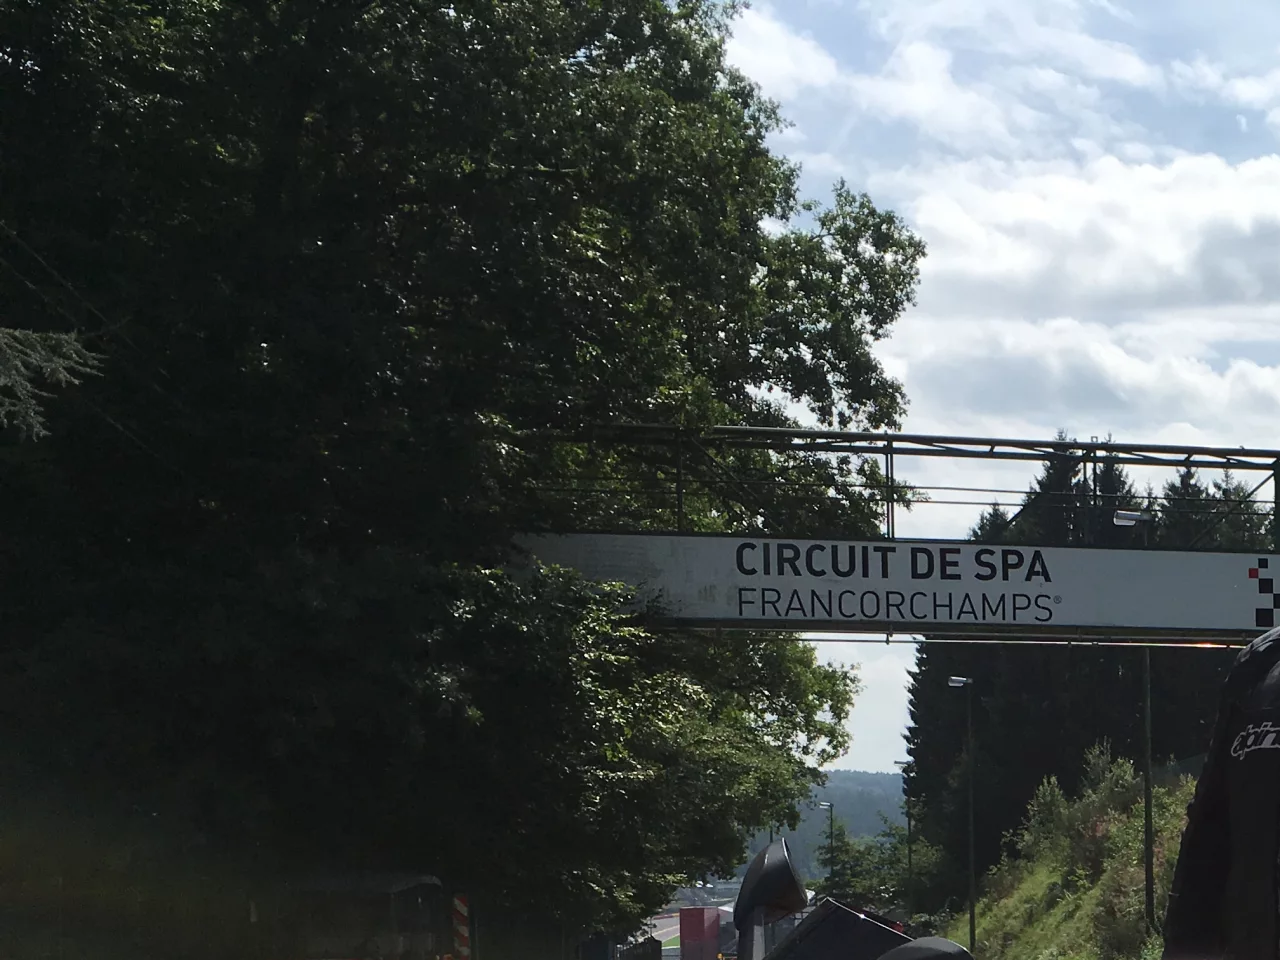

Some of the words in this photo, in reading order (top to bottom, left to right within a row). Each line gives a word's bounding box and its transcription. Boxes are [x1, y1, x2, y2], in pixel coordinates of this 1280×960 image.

[735, 542, 897, 579] CIRCUIT
[910, 548, 962, 580] DE
[973, 549, 1053, 583] SPA
